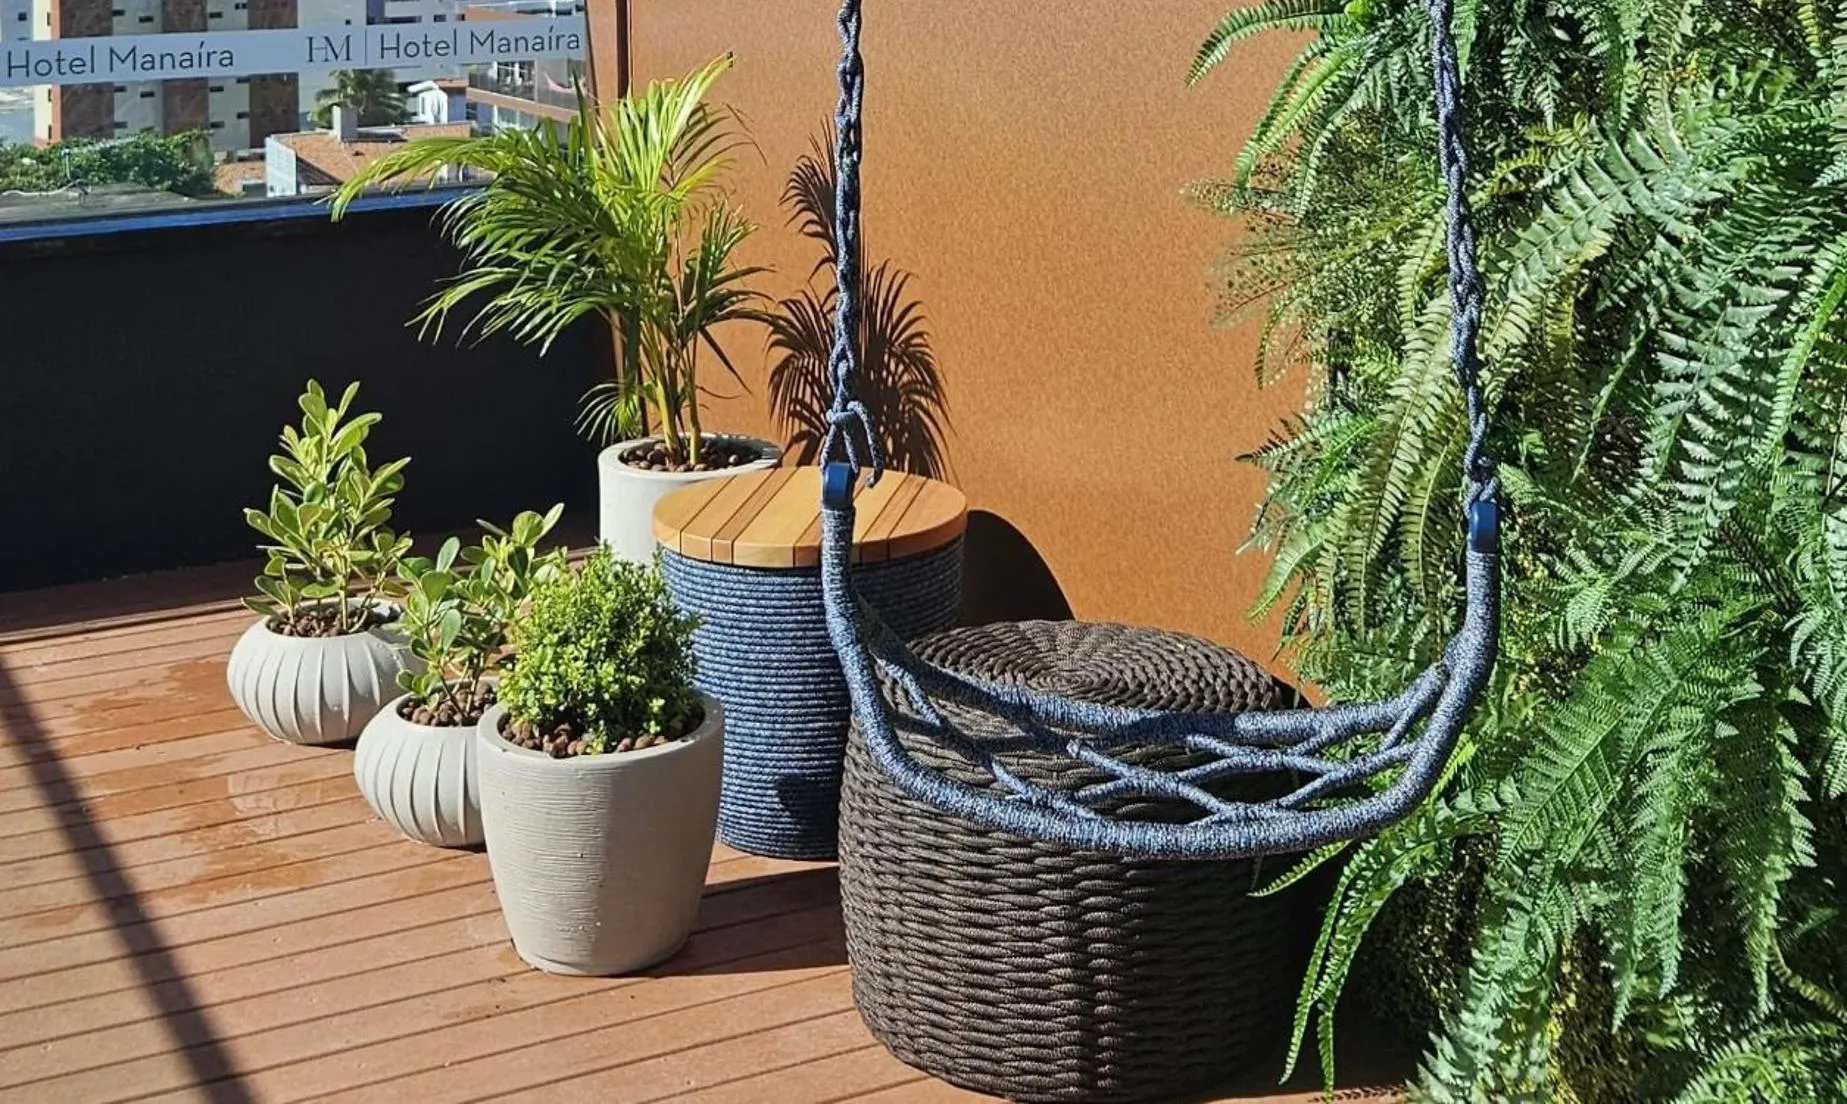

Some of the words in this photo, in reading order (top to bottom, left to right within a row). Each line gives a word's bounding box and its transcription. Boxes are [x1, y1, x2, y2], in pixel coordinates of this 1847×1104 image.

[7, 45, 95, 79] Hotel
[109, 41, 234, 73] Manaíra
[306, 35, 353, 63] HM
[380, 29, 457, 59] Hotel
[470, 25, 581, 55] Manaíra
